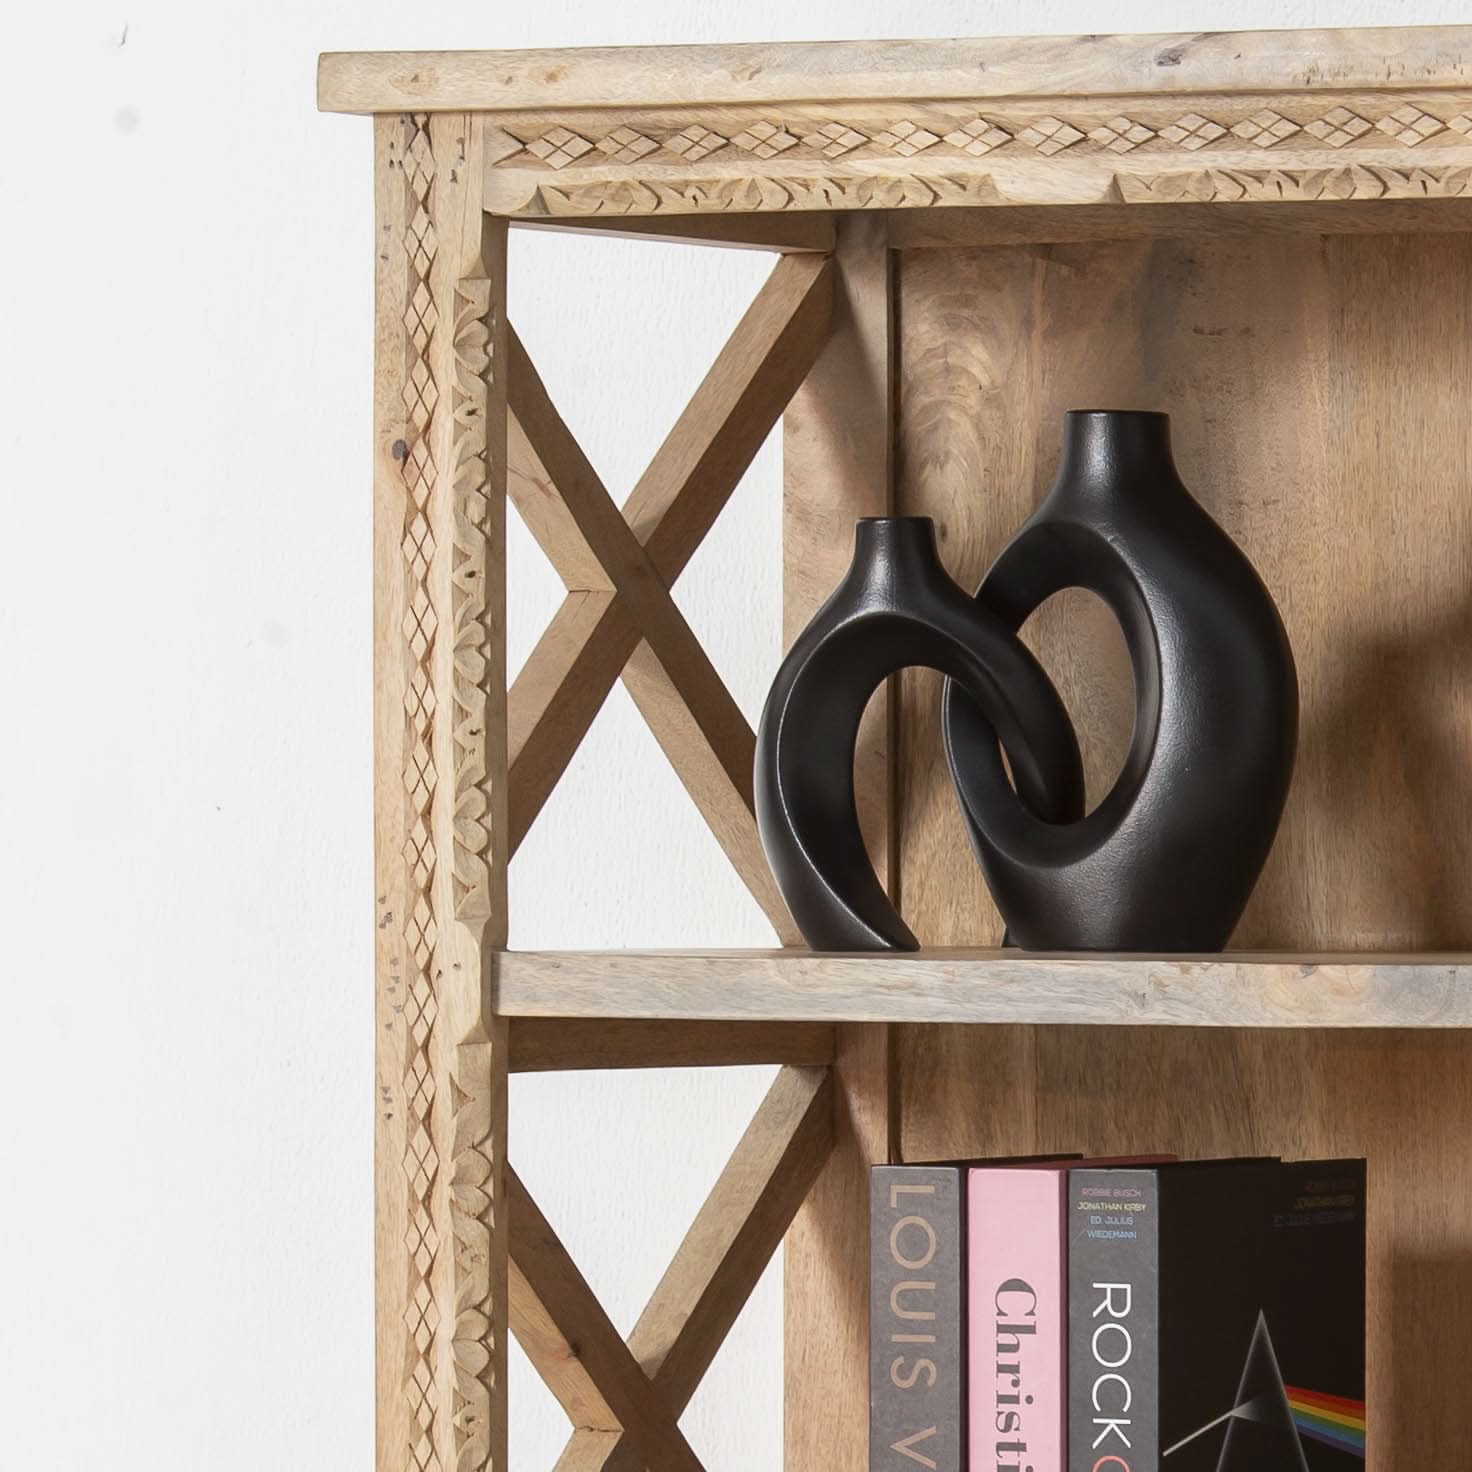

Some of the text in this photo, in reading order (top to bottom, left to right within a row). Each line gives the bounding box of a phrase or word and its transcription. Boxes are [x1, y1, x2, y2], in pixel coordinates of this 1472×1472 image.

[1077, 1202, 1122, 1211] JONATHAN
[1105, 1216, 1134, 1226] JULIUS
[890, 1184, 937, 1388] LOUIS
